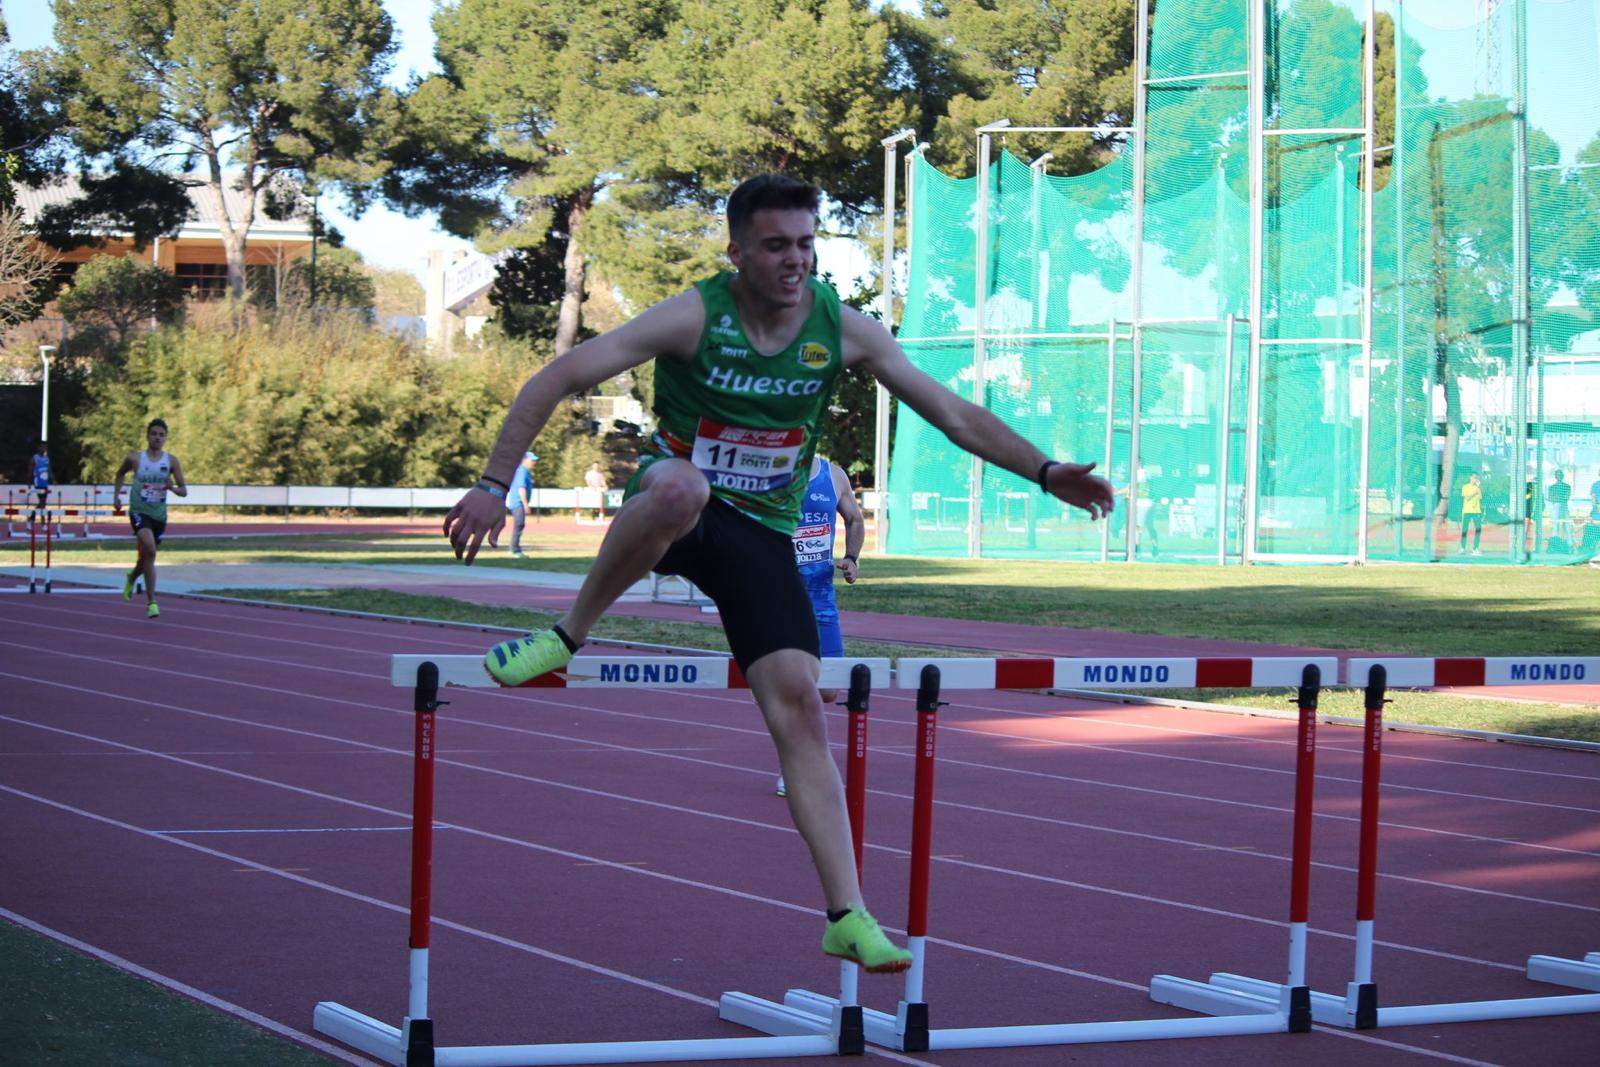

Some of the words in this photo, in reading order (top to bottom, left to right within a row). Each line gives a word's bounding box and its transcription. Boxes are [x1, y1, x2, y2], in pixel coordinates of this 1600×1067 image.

[706, 366, 823, 396] Huesca
[708, 444, 737, 469] 11
[600, 663, 697, 683] MONDO
[1084, 665, 1169, 682] MONDO
[1511, 664, 1585, 680] MONDO
